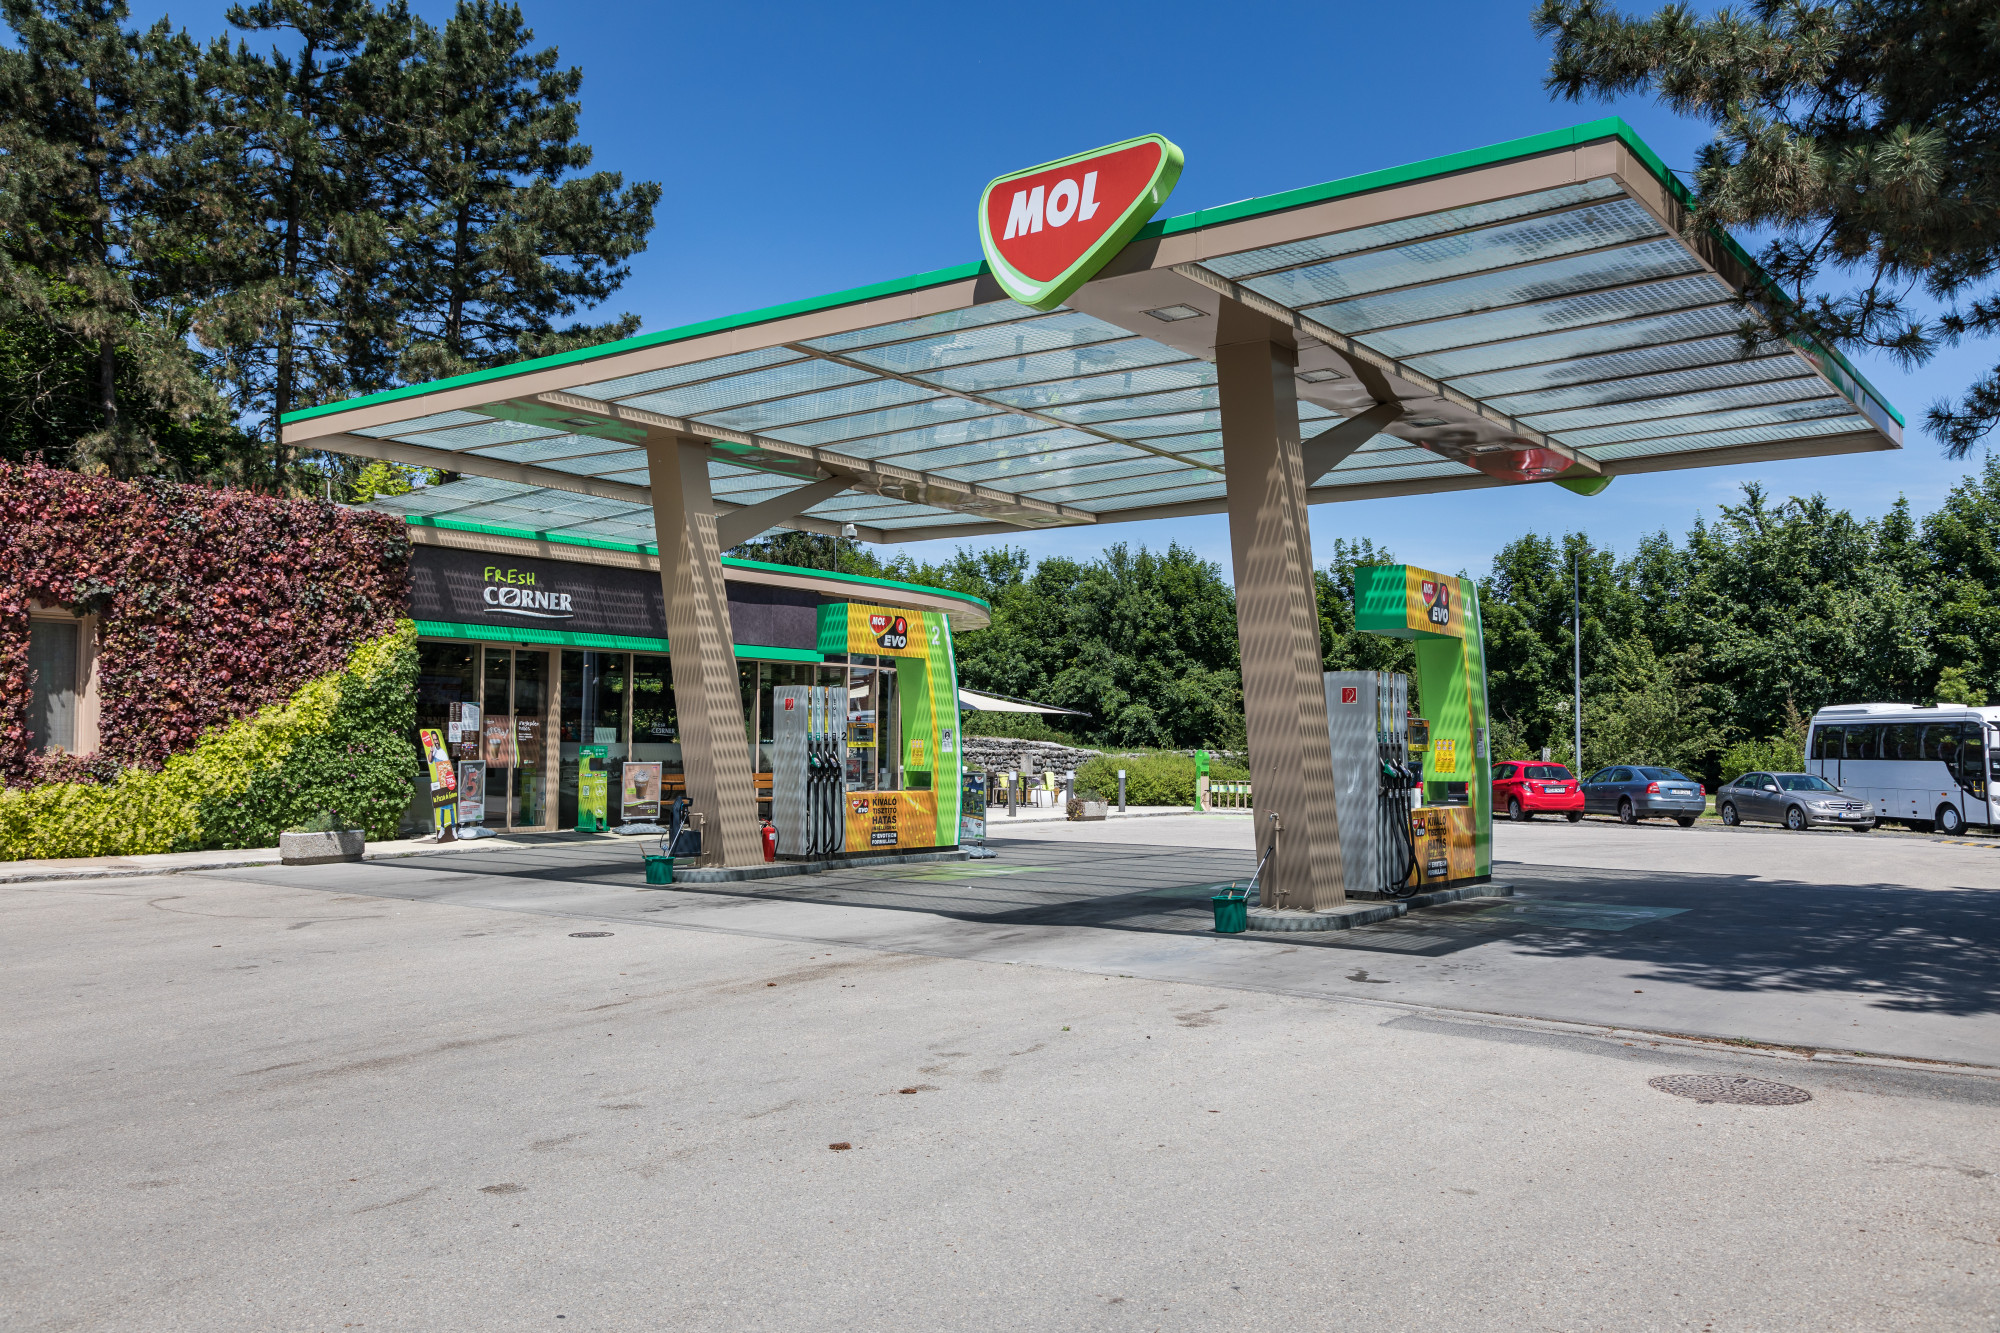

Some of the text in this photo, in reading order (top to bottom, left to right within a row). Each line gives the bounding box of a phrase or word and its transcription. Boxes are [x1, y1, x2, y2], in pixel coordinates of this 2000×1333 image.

[1003, 170, 1100, 240] MOL
[484, 566, 535, 585] FRESH
[1423, 582, 1433, 594] MOL
[483, 586, 573, 611] CORNER
[1432, 606, 1449, 623] EVO
[1464, 597, 1472, 621] 4
[871, 616, 886, 626] MOL
[883, 634, 907, 648] EVO
[931, 625, 941, 645] 2
[841, 731, 847, 741] 2
[1403, 730, 1408, 741] 4
[465, 772, 478, 797] 5
[872, 796, 897, 806] KIVÁLÓ
[872, 806, 897, 815] TISZTÍTÓ
[872, 814, 897, 824] HATÁS
